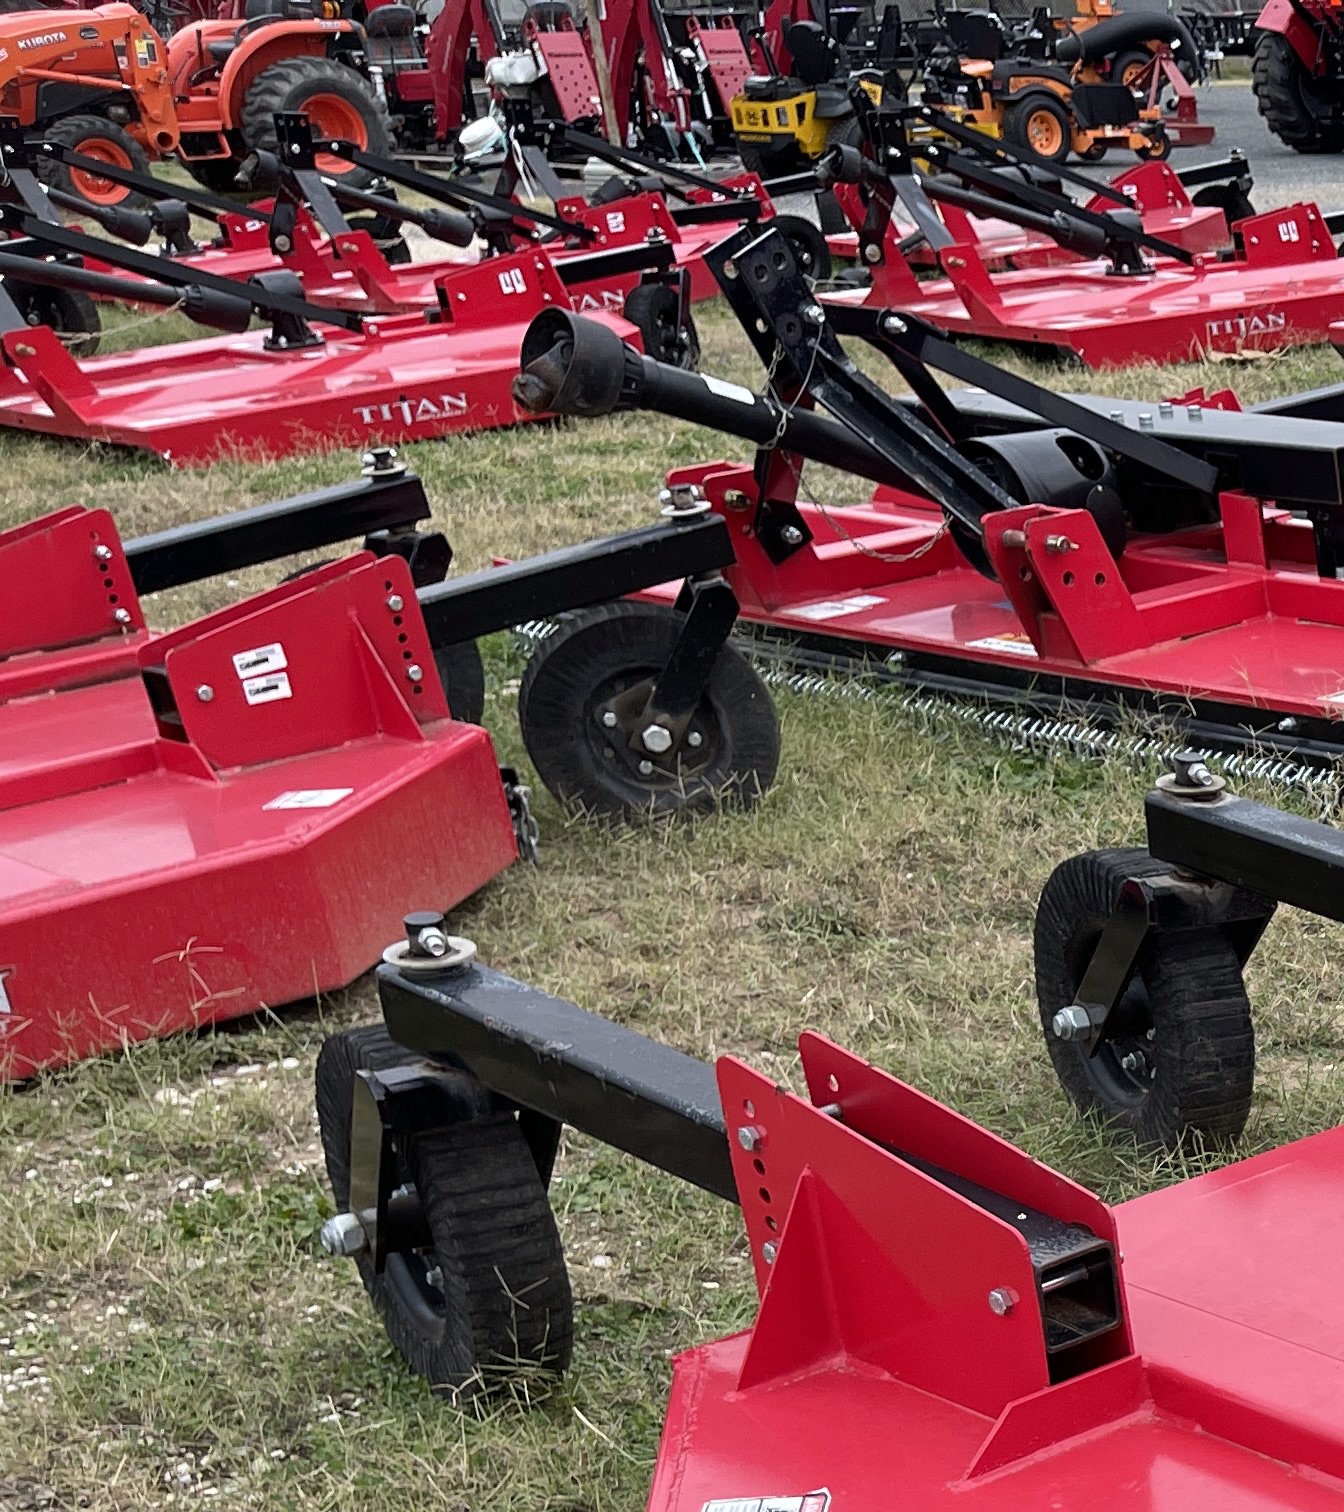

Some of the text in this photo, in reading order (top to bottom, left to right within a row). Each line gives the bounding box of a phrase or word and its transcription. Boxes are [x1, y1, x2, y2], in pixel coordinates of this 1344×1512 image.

[17, 31, 67, 49] KUBOTA
[569, 289, 623, 312] TAN
[1206, 312, 1286, 339] TITAN
[353, 392, 468, 427] TITAN
